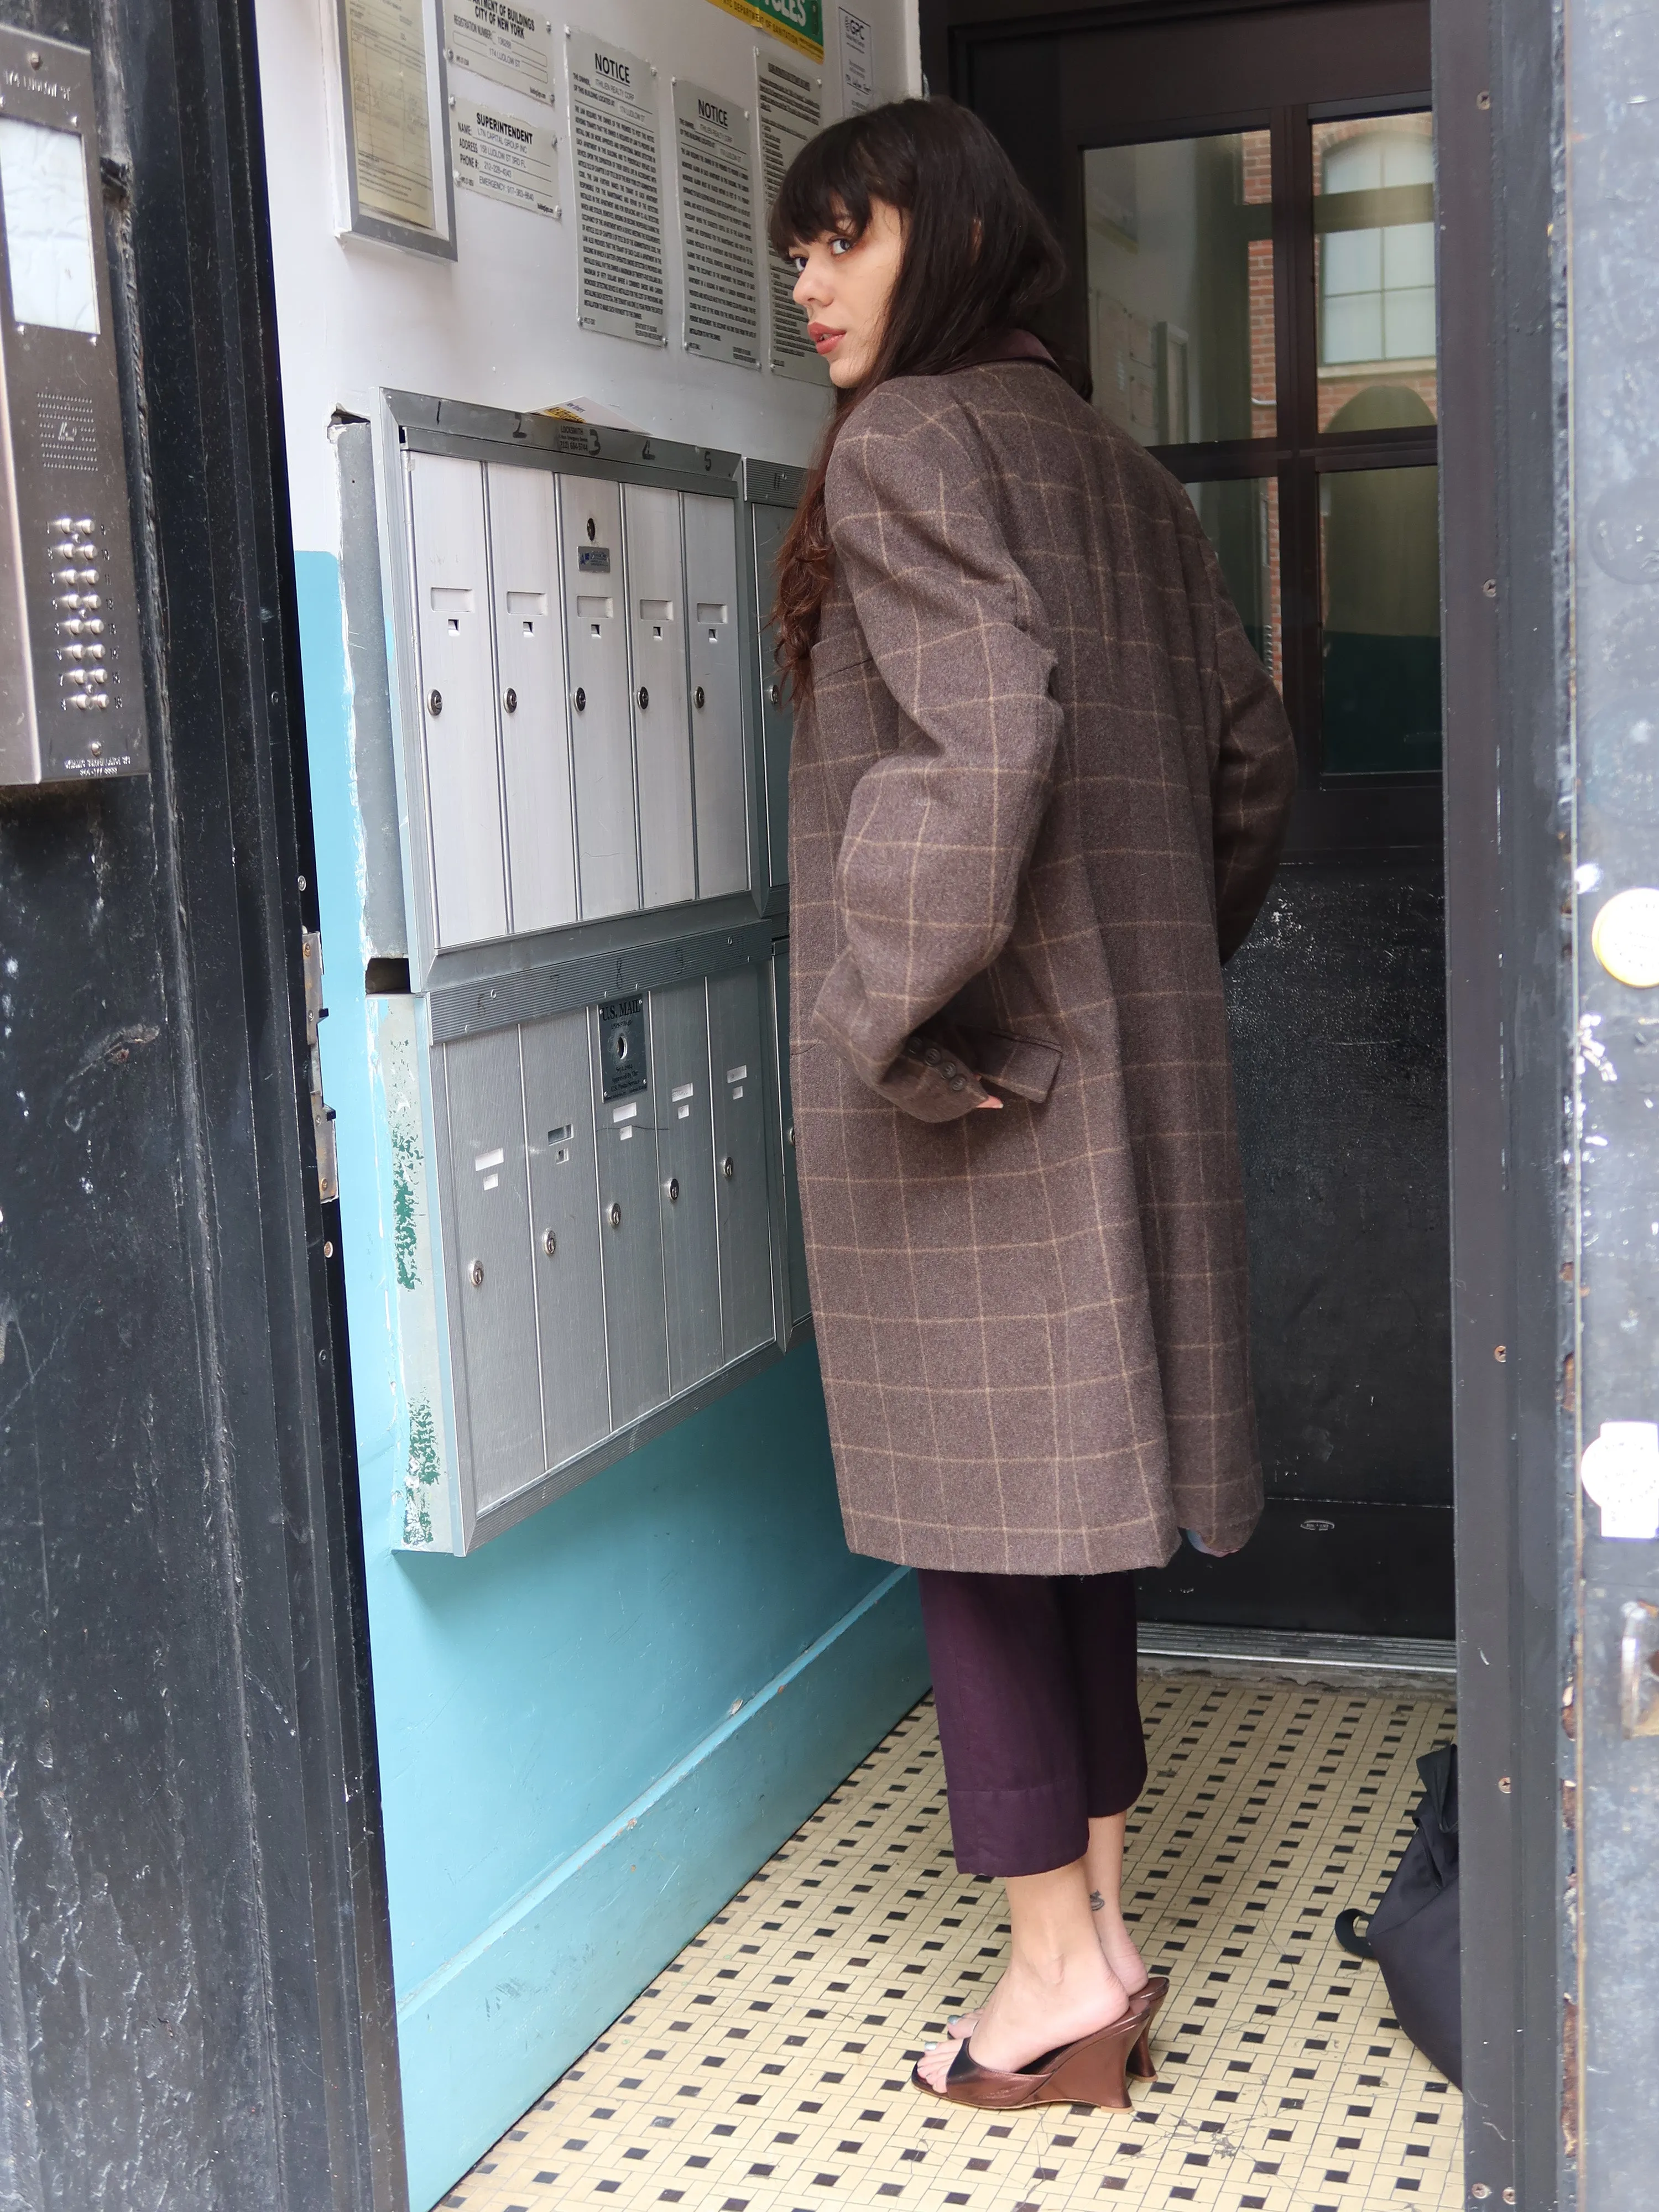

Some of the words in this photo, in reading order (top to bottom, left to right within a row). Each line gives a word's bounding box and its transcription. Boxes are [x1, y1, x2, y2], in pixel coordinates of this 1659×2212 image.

[475, 6, 487, 22] CITY
[489, 12, 495, 25] OF
[498, 15, 509, 32] NEW
[510, 22, 525, 39] YORK
[499, 4, 505, 17] OF
[508, 8, 535, 32] BUILDINGS
[595, 53, 630, 84] NOTICE
[698, 99, 728, 127] NOTICE
[476, 112, 533, 144] SUPERINTENDENT
[487, 131, 503, 145] CAPITAL
[504, 138, 519, 150] GROUP
[460, 153, 474, 168] PHONE
[436, 401, 441, 426] 1
[512, 413, 527, 439] 2
[588, 429, 601, 456] 3
[642, 440, 656, 460] 4
[703, 451, 712, 471] 5
[616, 957, 623, 989] 8
[602, 1005, 617, 1021] U.S.
[619, 999, 641, 1017] MAIL
